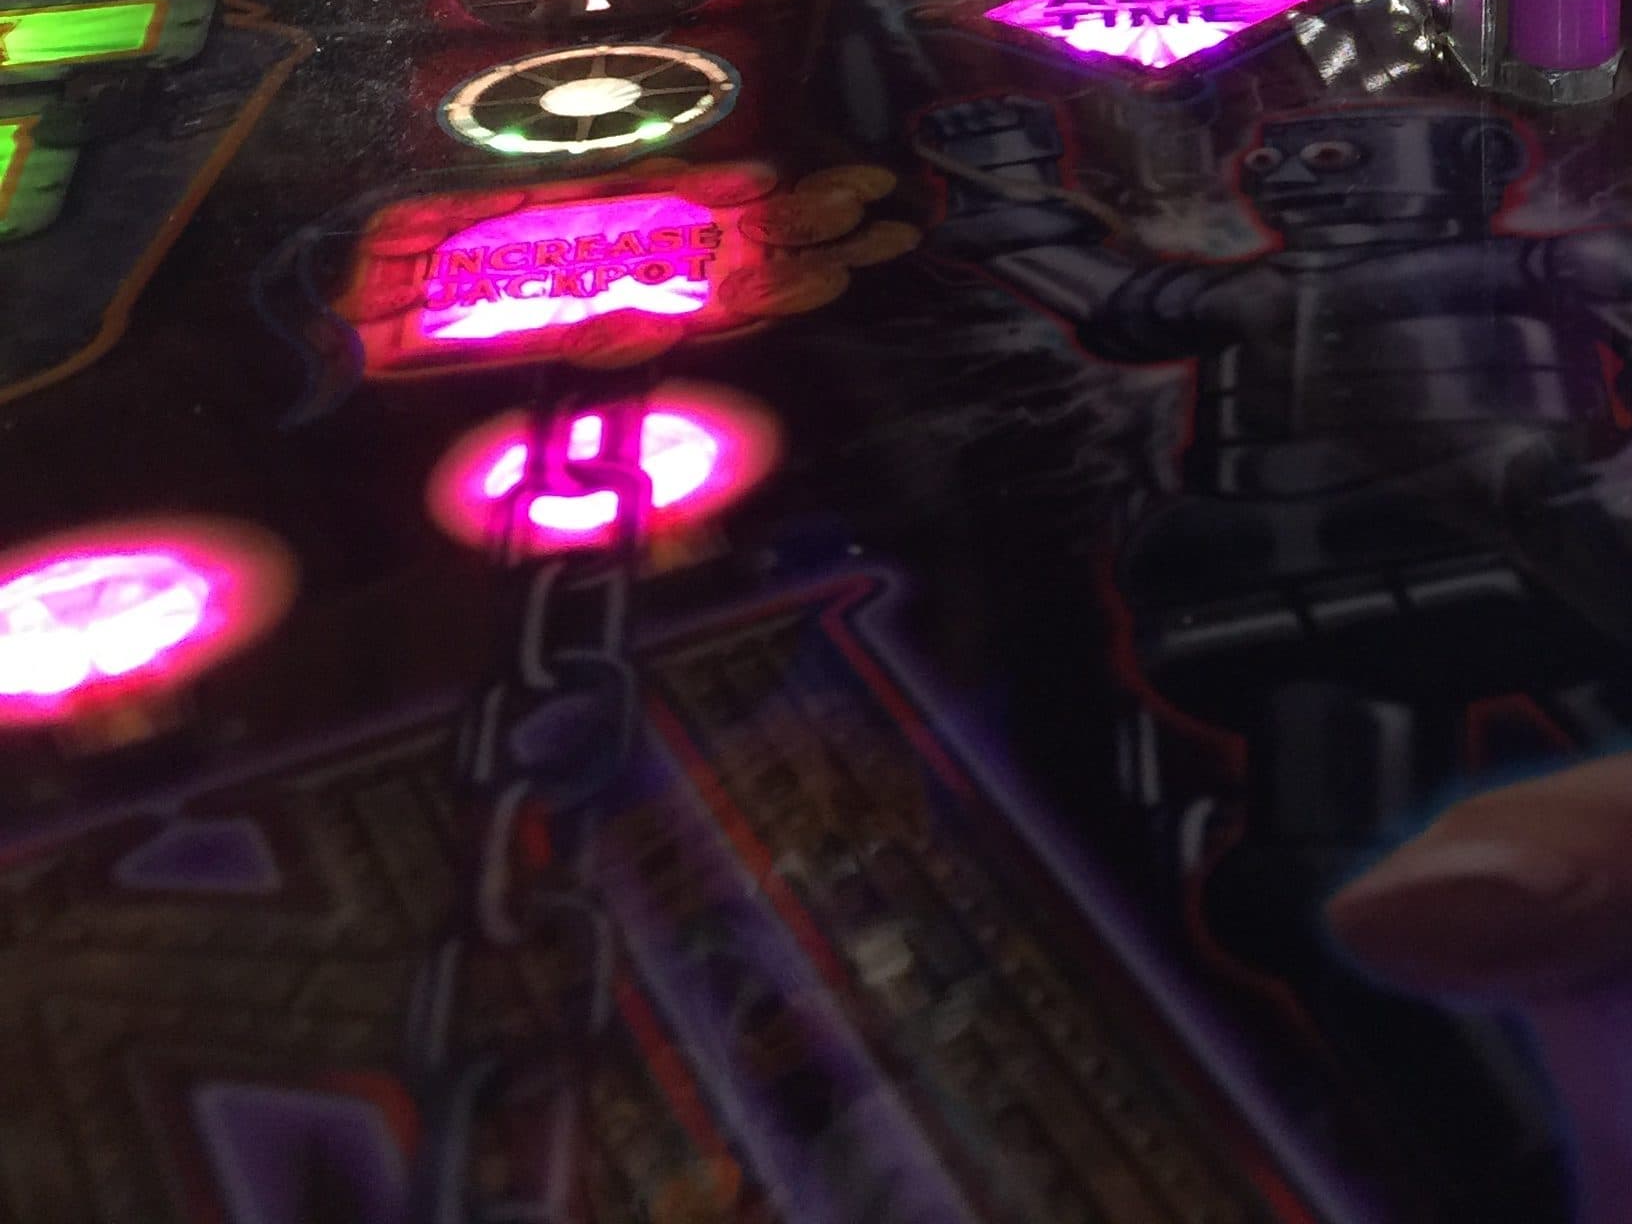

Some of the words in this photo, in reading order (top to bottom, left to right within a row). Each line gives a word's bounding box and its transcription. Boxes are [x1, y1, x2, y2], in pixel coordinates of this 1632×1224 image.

[1043, 2, 1247, 30] TIME
[425, 222, 721, 283] INCREASE
[422, 253, 718, 310] JACKPOT
